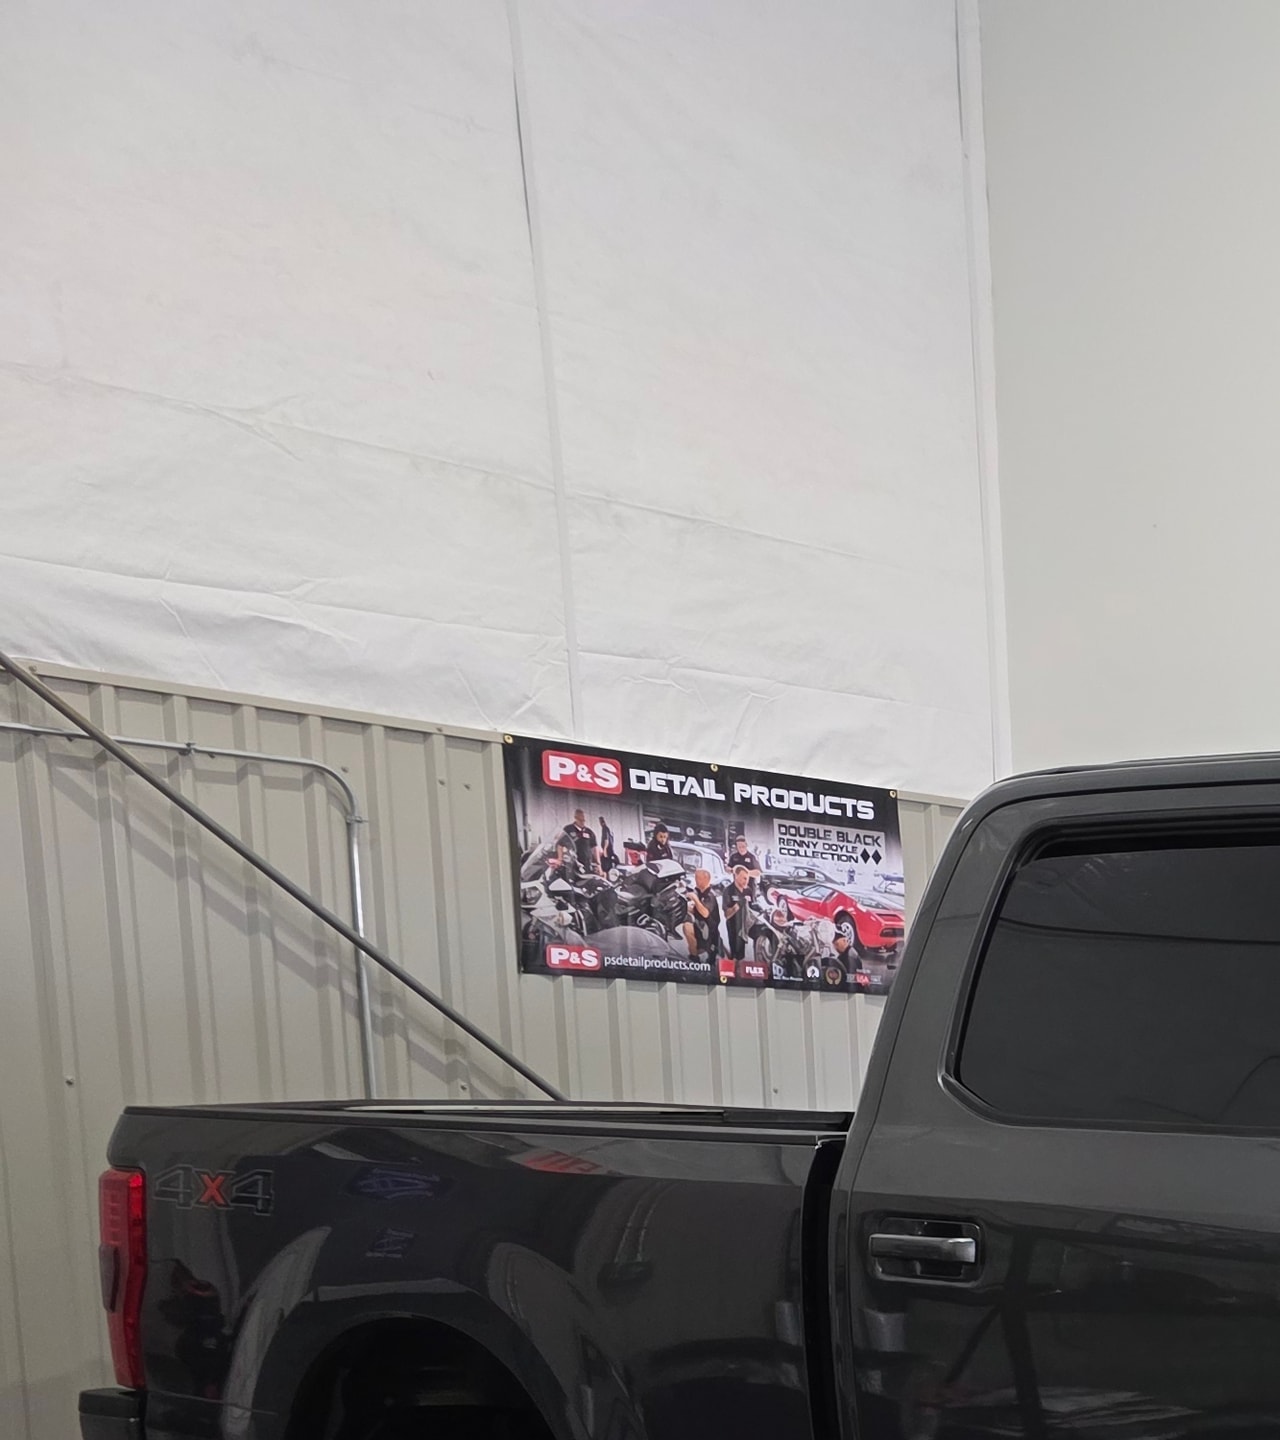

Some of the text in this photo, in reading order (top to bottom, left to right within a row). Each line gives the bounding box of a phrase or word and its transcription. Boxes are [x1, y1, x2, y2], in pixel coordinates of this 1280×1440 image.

[549, 754, 875, 820] P&S DETAIL PRODUCTS
[778, 823, 882, 847] DOUBLE BLACK
[779, 837, 858, 854] RENNY DOYLE
[779, 847, 859, 863] COLLECTION
[550, 947, 598, 967] P&S
[604, 955, 711, 972] psdetailproducts.com
